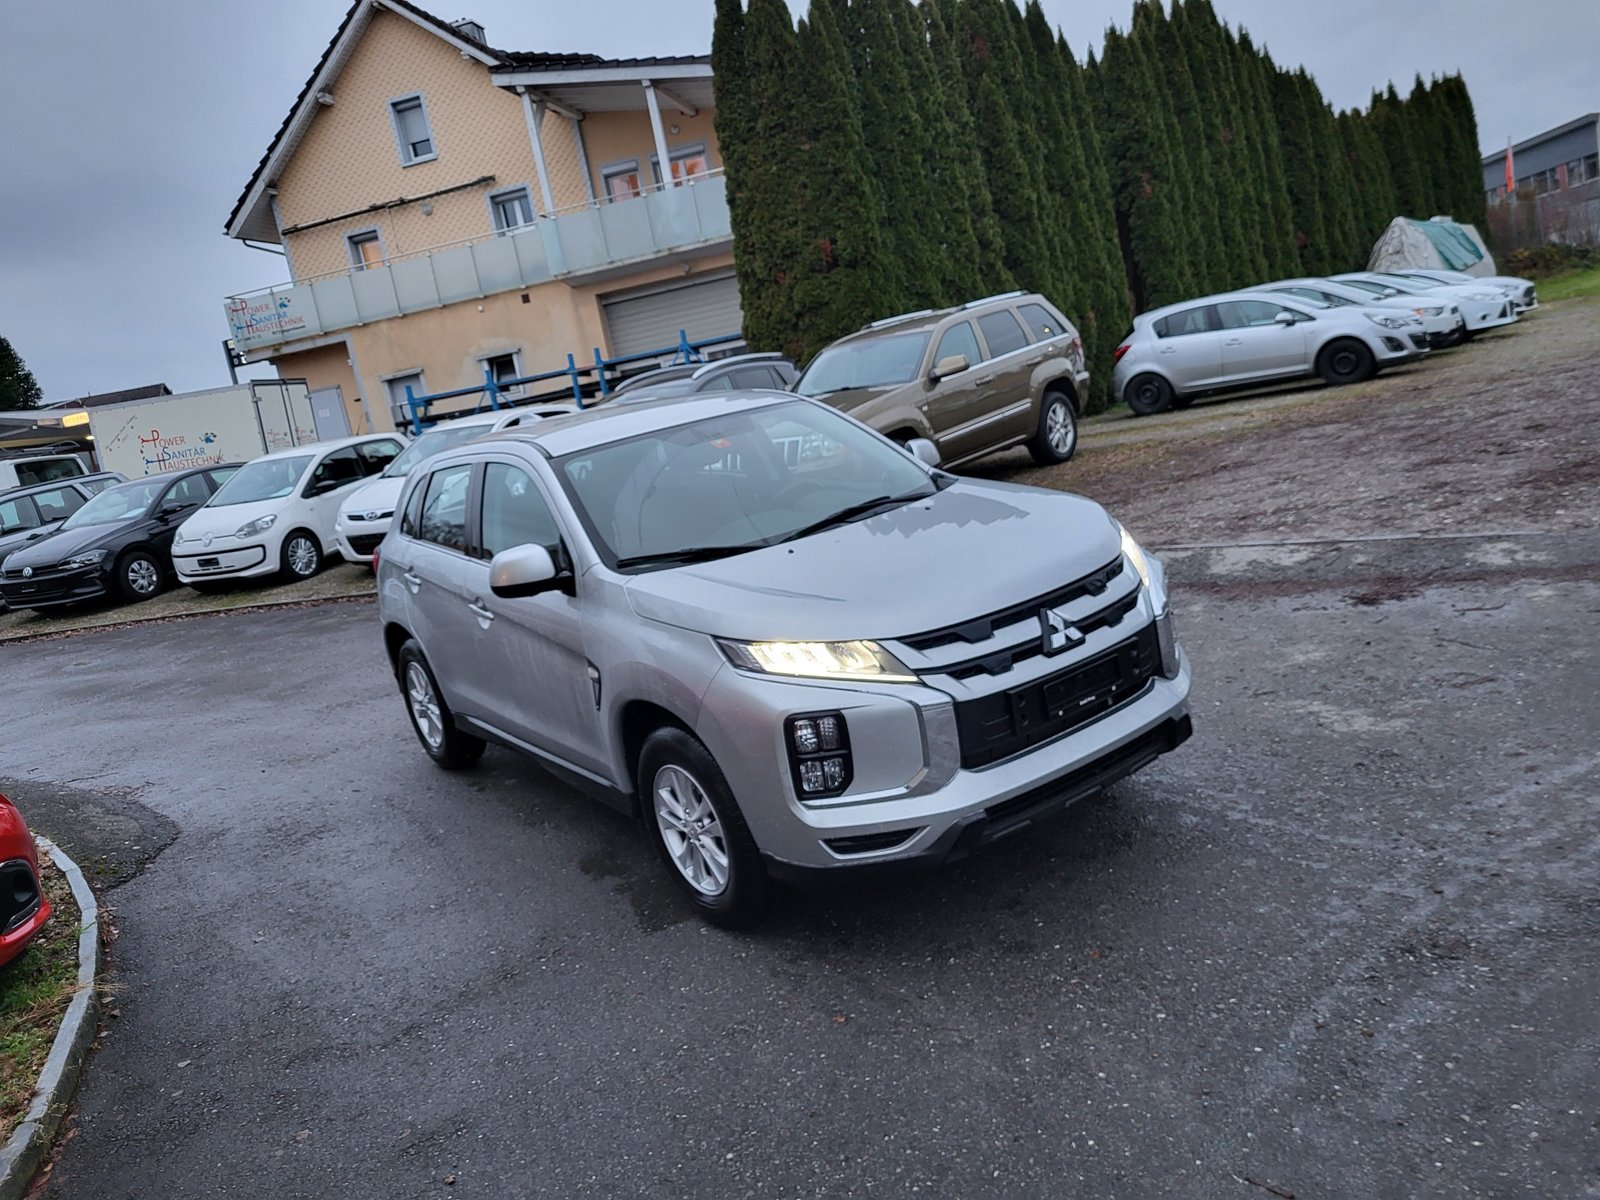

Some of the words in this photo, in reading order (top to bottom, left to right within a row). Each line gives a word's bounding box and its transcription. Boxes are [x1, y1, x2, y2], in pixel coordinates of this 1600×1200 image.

[240, 300, 271, 316] POWER
[245, 316, 305, 335] HAUSTECHNIK
[149, 429, 186, 448] POWER
[156, 452, 226, 471] HAUSTECHNIK
